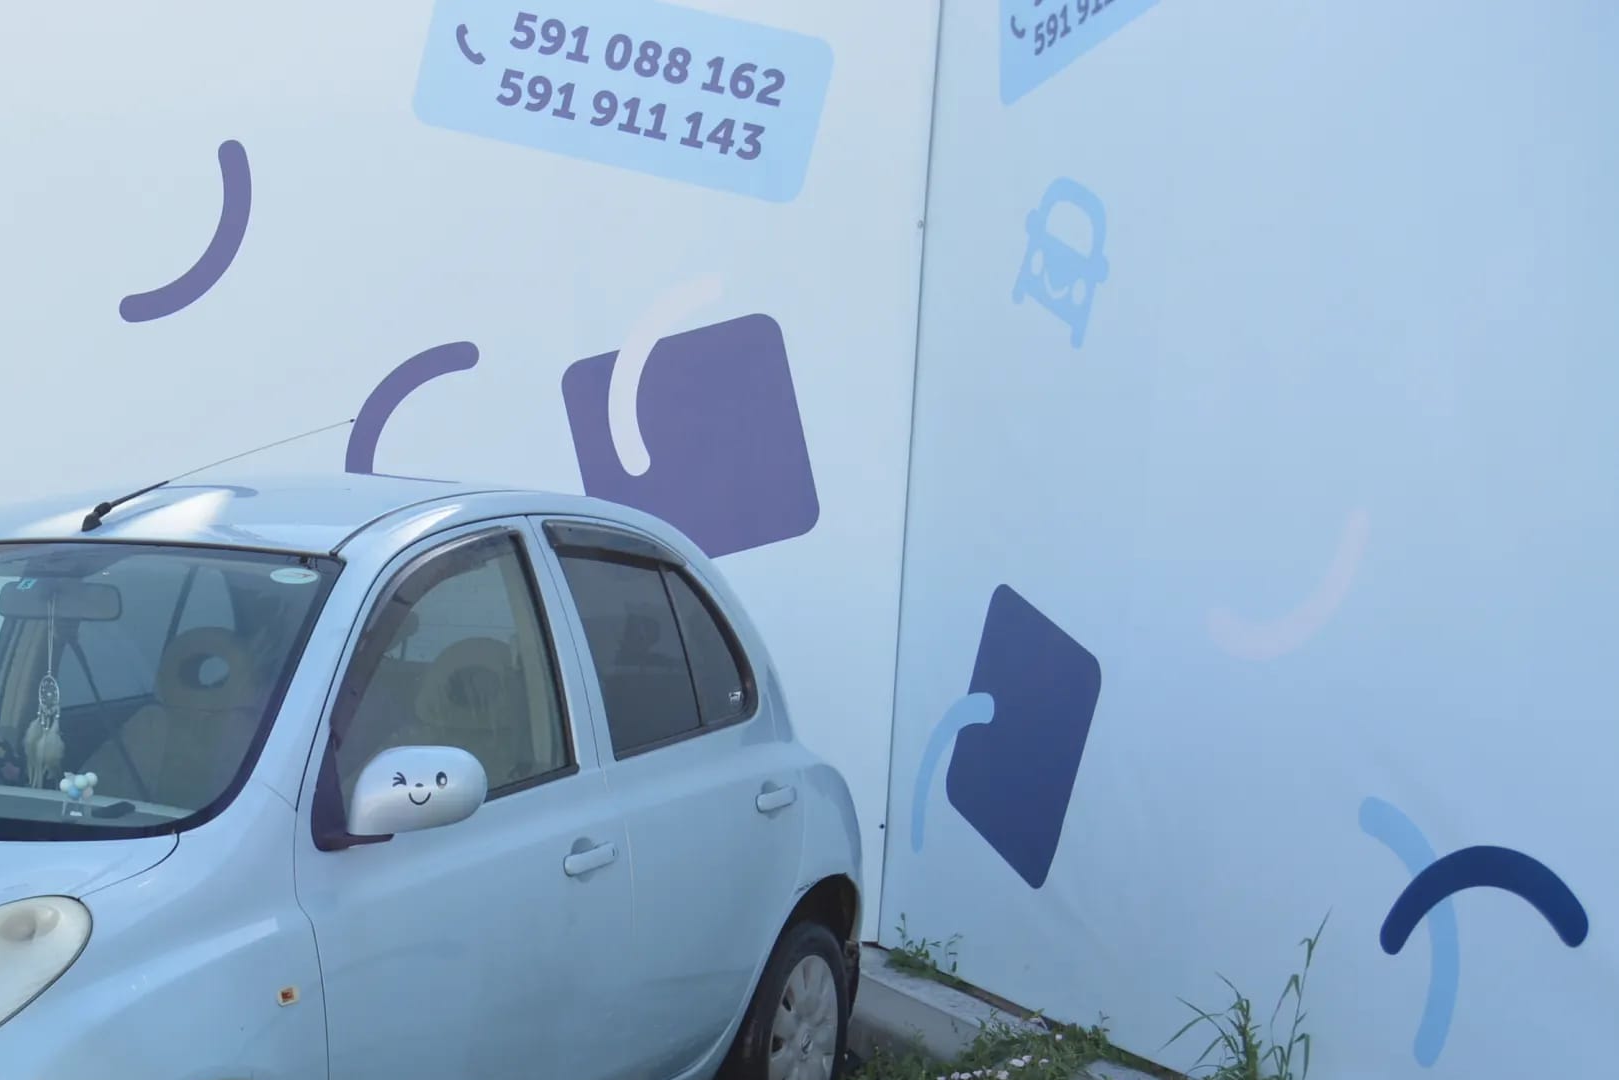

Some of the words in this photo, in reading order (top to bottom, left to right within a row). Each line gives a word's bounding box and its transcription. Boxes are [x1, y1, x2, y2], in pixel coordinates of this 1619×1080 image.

[509, 11, 590, 64] 591
[604, 33, 692, 84] 088
[700, 56, 786, 107] 162
[1034, 4, 1072, 56] 591
[495, 68, 576, 121] 591
[589, 90, 668, 141] 911
[679, 111, 766, 161] 143
